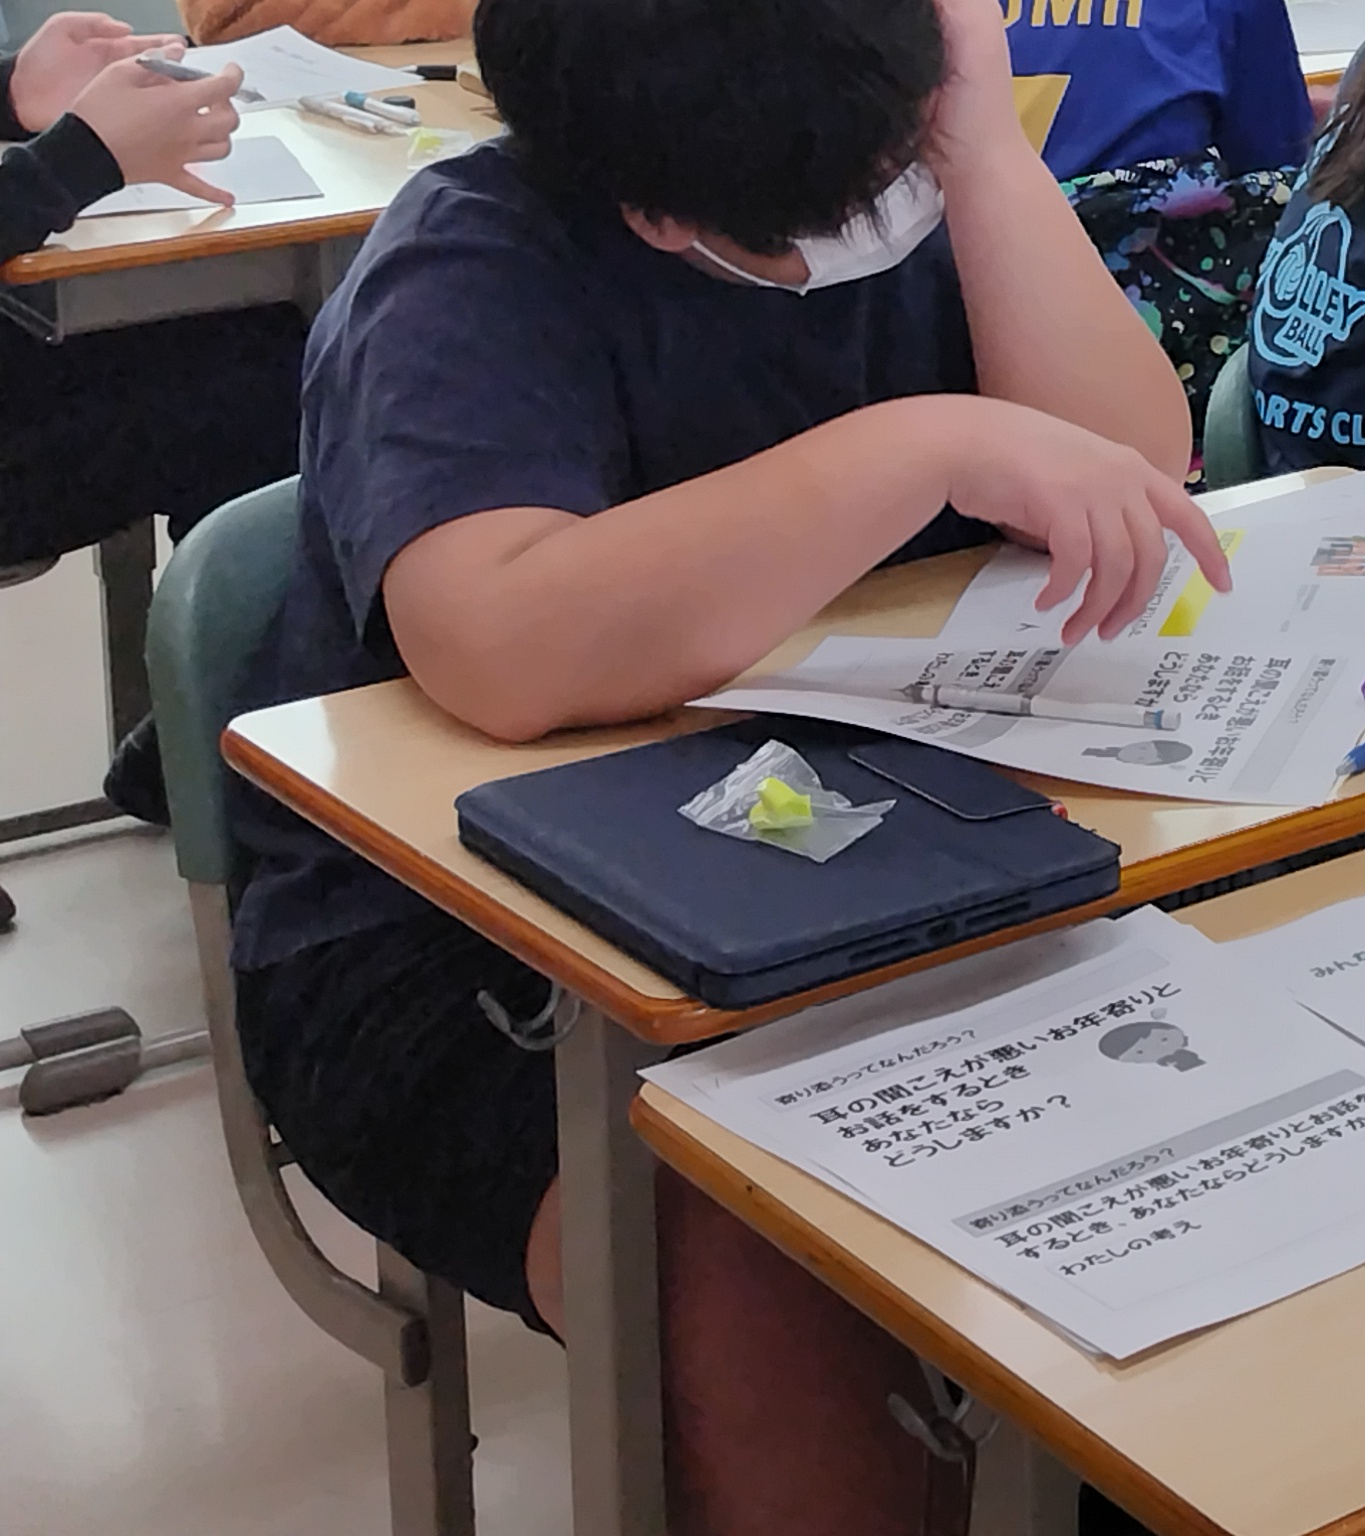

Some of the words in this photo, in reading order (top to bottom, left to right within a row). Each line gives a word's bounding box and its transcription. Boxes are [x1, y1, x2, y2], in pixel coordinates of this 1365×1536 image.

[1283, 315, 1324, 356] BALL
[774, 1029, 977, 1108] 寄り添うってなんだろう?
[809, 981, 1183, 1126] 耳の聞こえが悪いお年寄りと
[836, 1063, 1032, 1140] お話をするとき
[861, 1096, 1005, 1154] あなたなら
[883, 1093, 1072, 1169] どうしますか?
[968, 1146, 1176, 1232] 寄り添うってなんだろう?
[1058, 1219, 1203, 1278] わたしの考え
